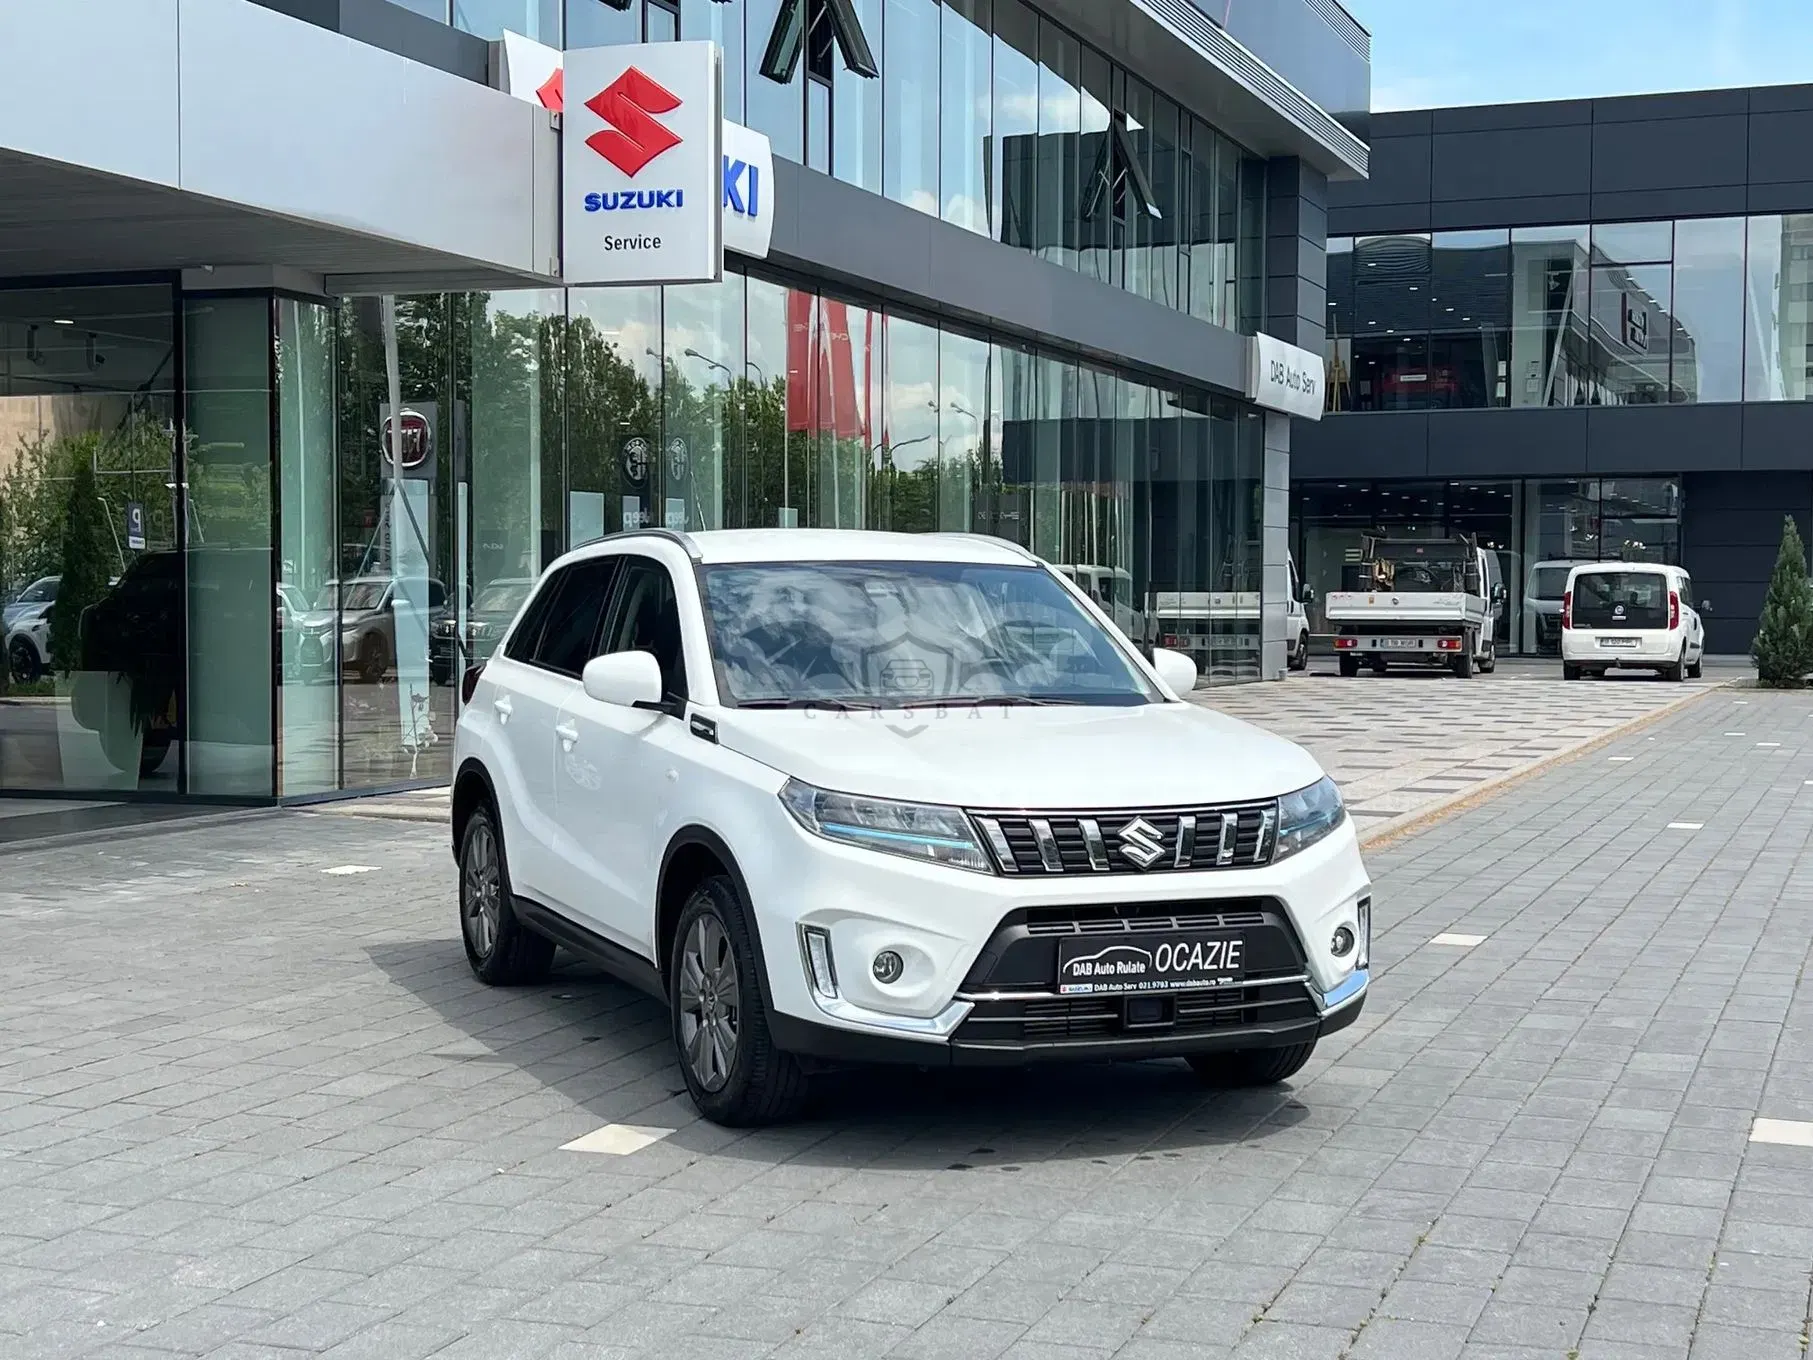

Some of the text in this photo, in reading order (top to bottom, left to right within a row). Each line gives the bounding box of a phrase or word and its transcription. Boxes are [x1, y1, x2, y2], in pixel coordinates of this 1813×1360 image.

[584, 189, 684, 212] SUZUKI
[604, 234, 662, 251] Service
[1270, 360, 1316, 396] DAB Auto Serv
[1072, 960, 1146, 976] DAB Auto Rulate
[1155, 940, 1243, 973] OCAZIE
